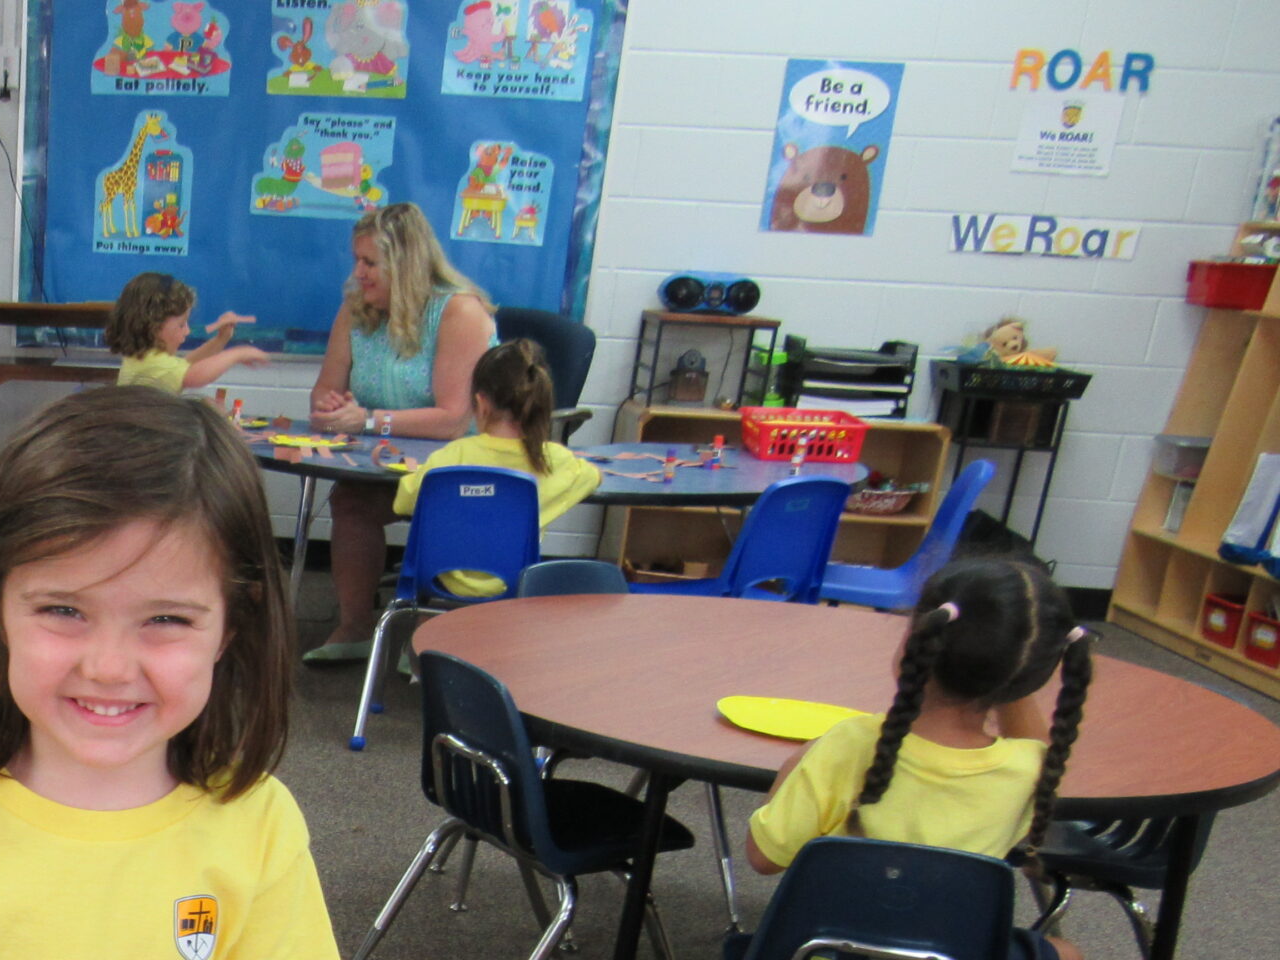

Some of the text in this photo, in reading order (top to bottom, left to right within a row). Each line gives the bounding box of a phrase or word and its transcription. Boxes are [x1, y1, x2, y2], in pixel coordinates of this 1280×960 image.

[456, 69, 575, 84] Keep your hands
[1009, 48, 1155, 92] ROAR
[115, 78, 209, 94] Eat politely.
[473, 81, 554, 95] to yourself.
[820, 77, 863, 95] Be a
[805, 94, 871, 115] friend.
[303, 116, 321, 128] Say
[373, 120, 393, 129] and
[1039, 131, 1094, 143] We ROAR!
[511, 156, 547, 169] Raise
[509, 169, 540, 184] your
[507, 181, 544, 194] hand.
[96, 242, 184, 254] Put things away.
[463, 486, 493, 495] Pre-K
